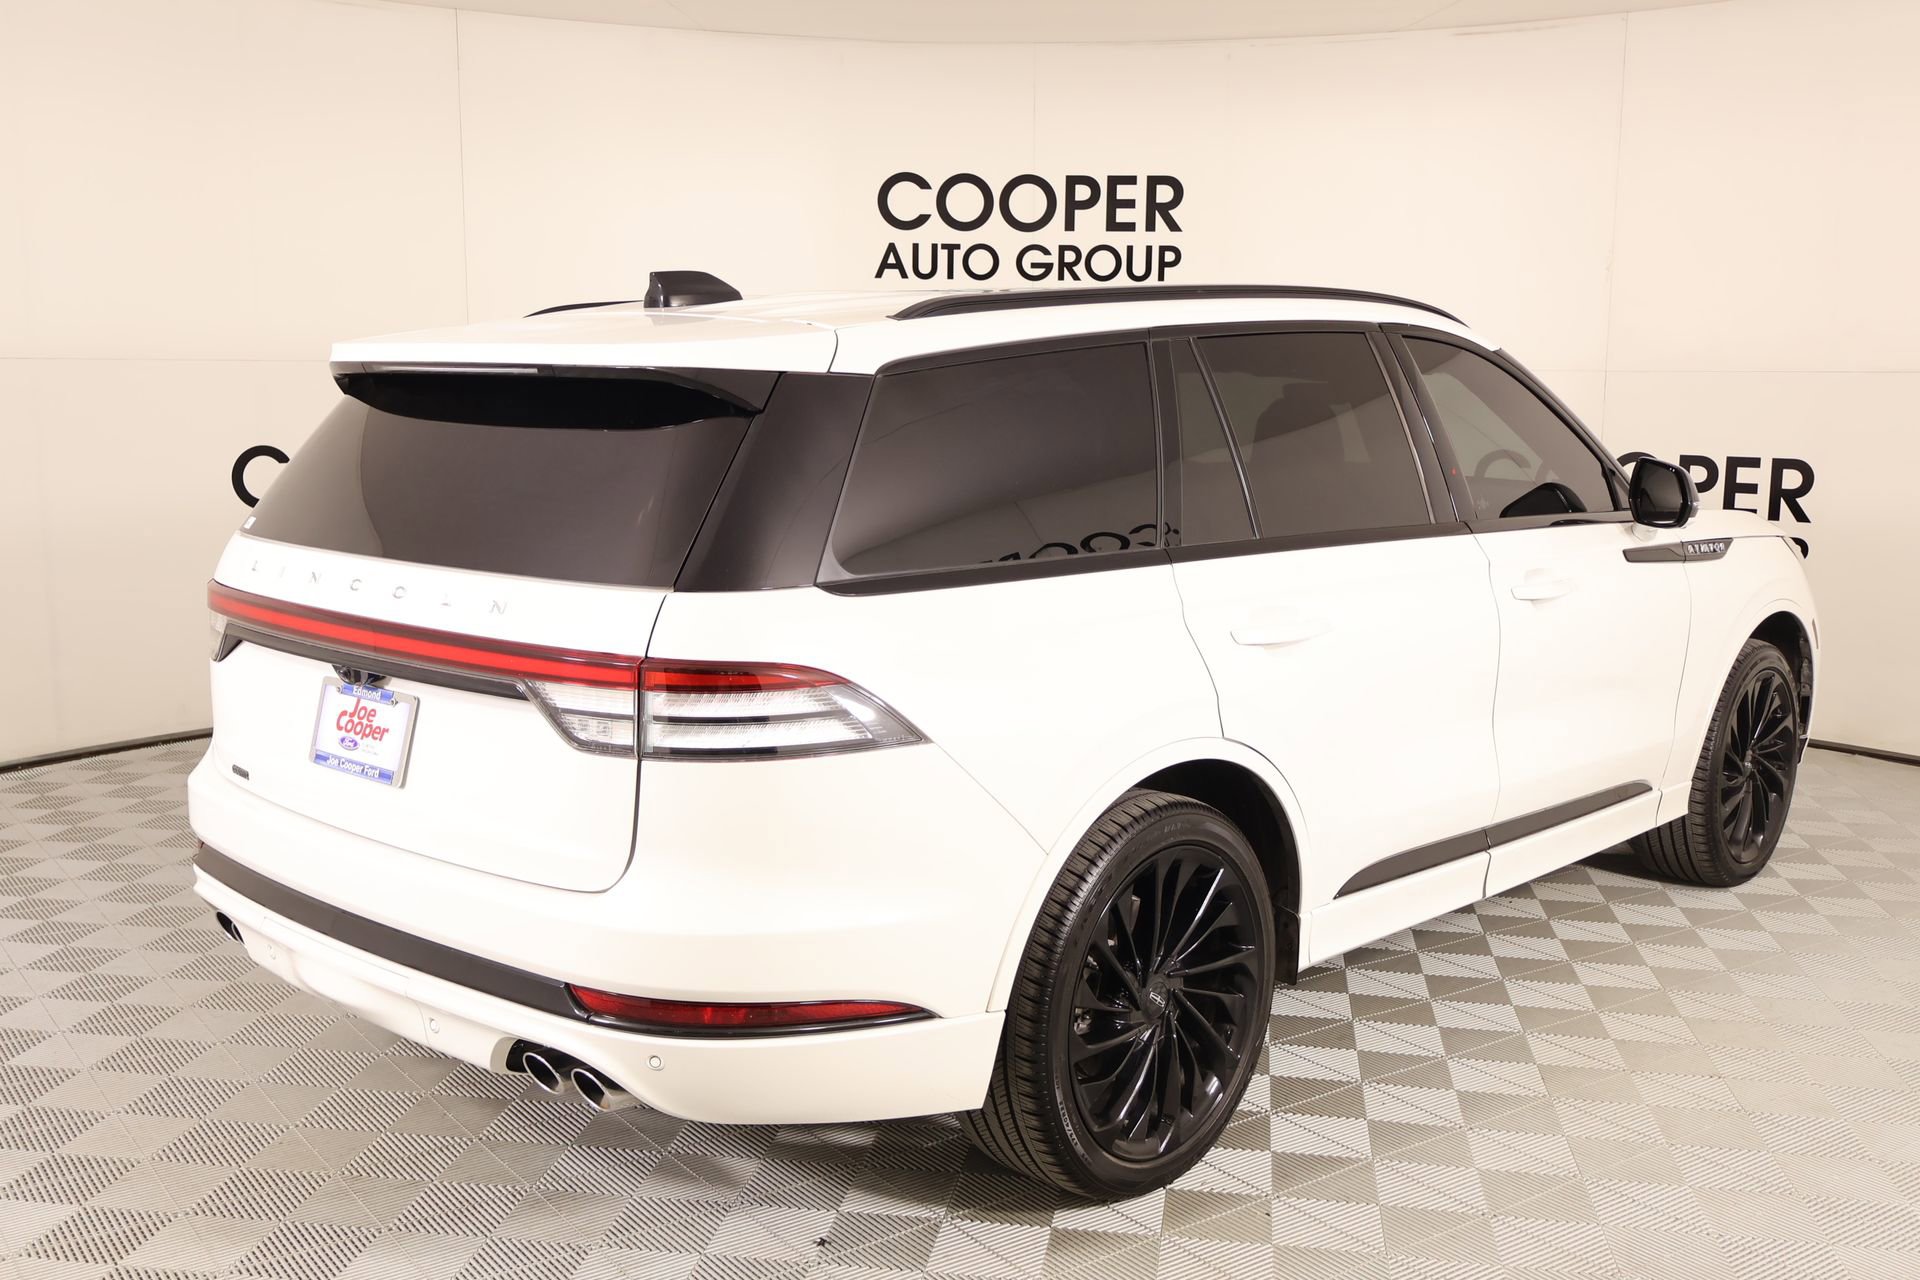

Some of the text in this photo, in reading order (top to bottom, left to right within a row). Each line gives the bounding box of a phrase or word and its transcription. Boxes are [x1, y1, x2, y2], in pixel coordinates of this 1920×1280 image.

[877, 171, 1184, 232] COOPER
[875, 242, 1182, 282] AUTO GROUP
[349, 697, 377, 722] Joe
[336, 710, 389, 742] Cooper
[326, 754, 379, 778] Joe Cooper Ford
